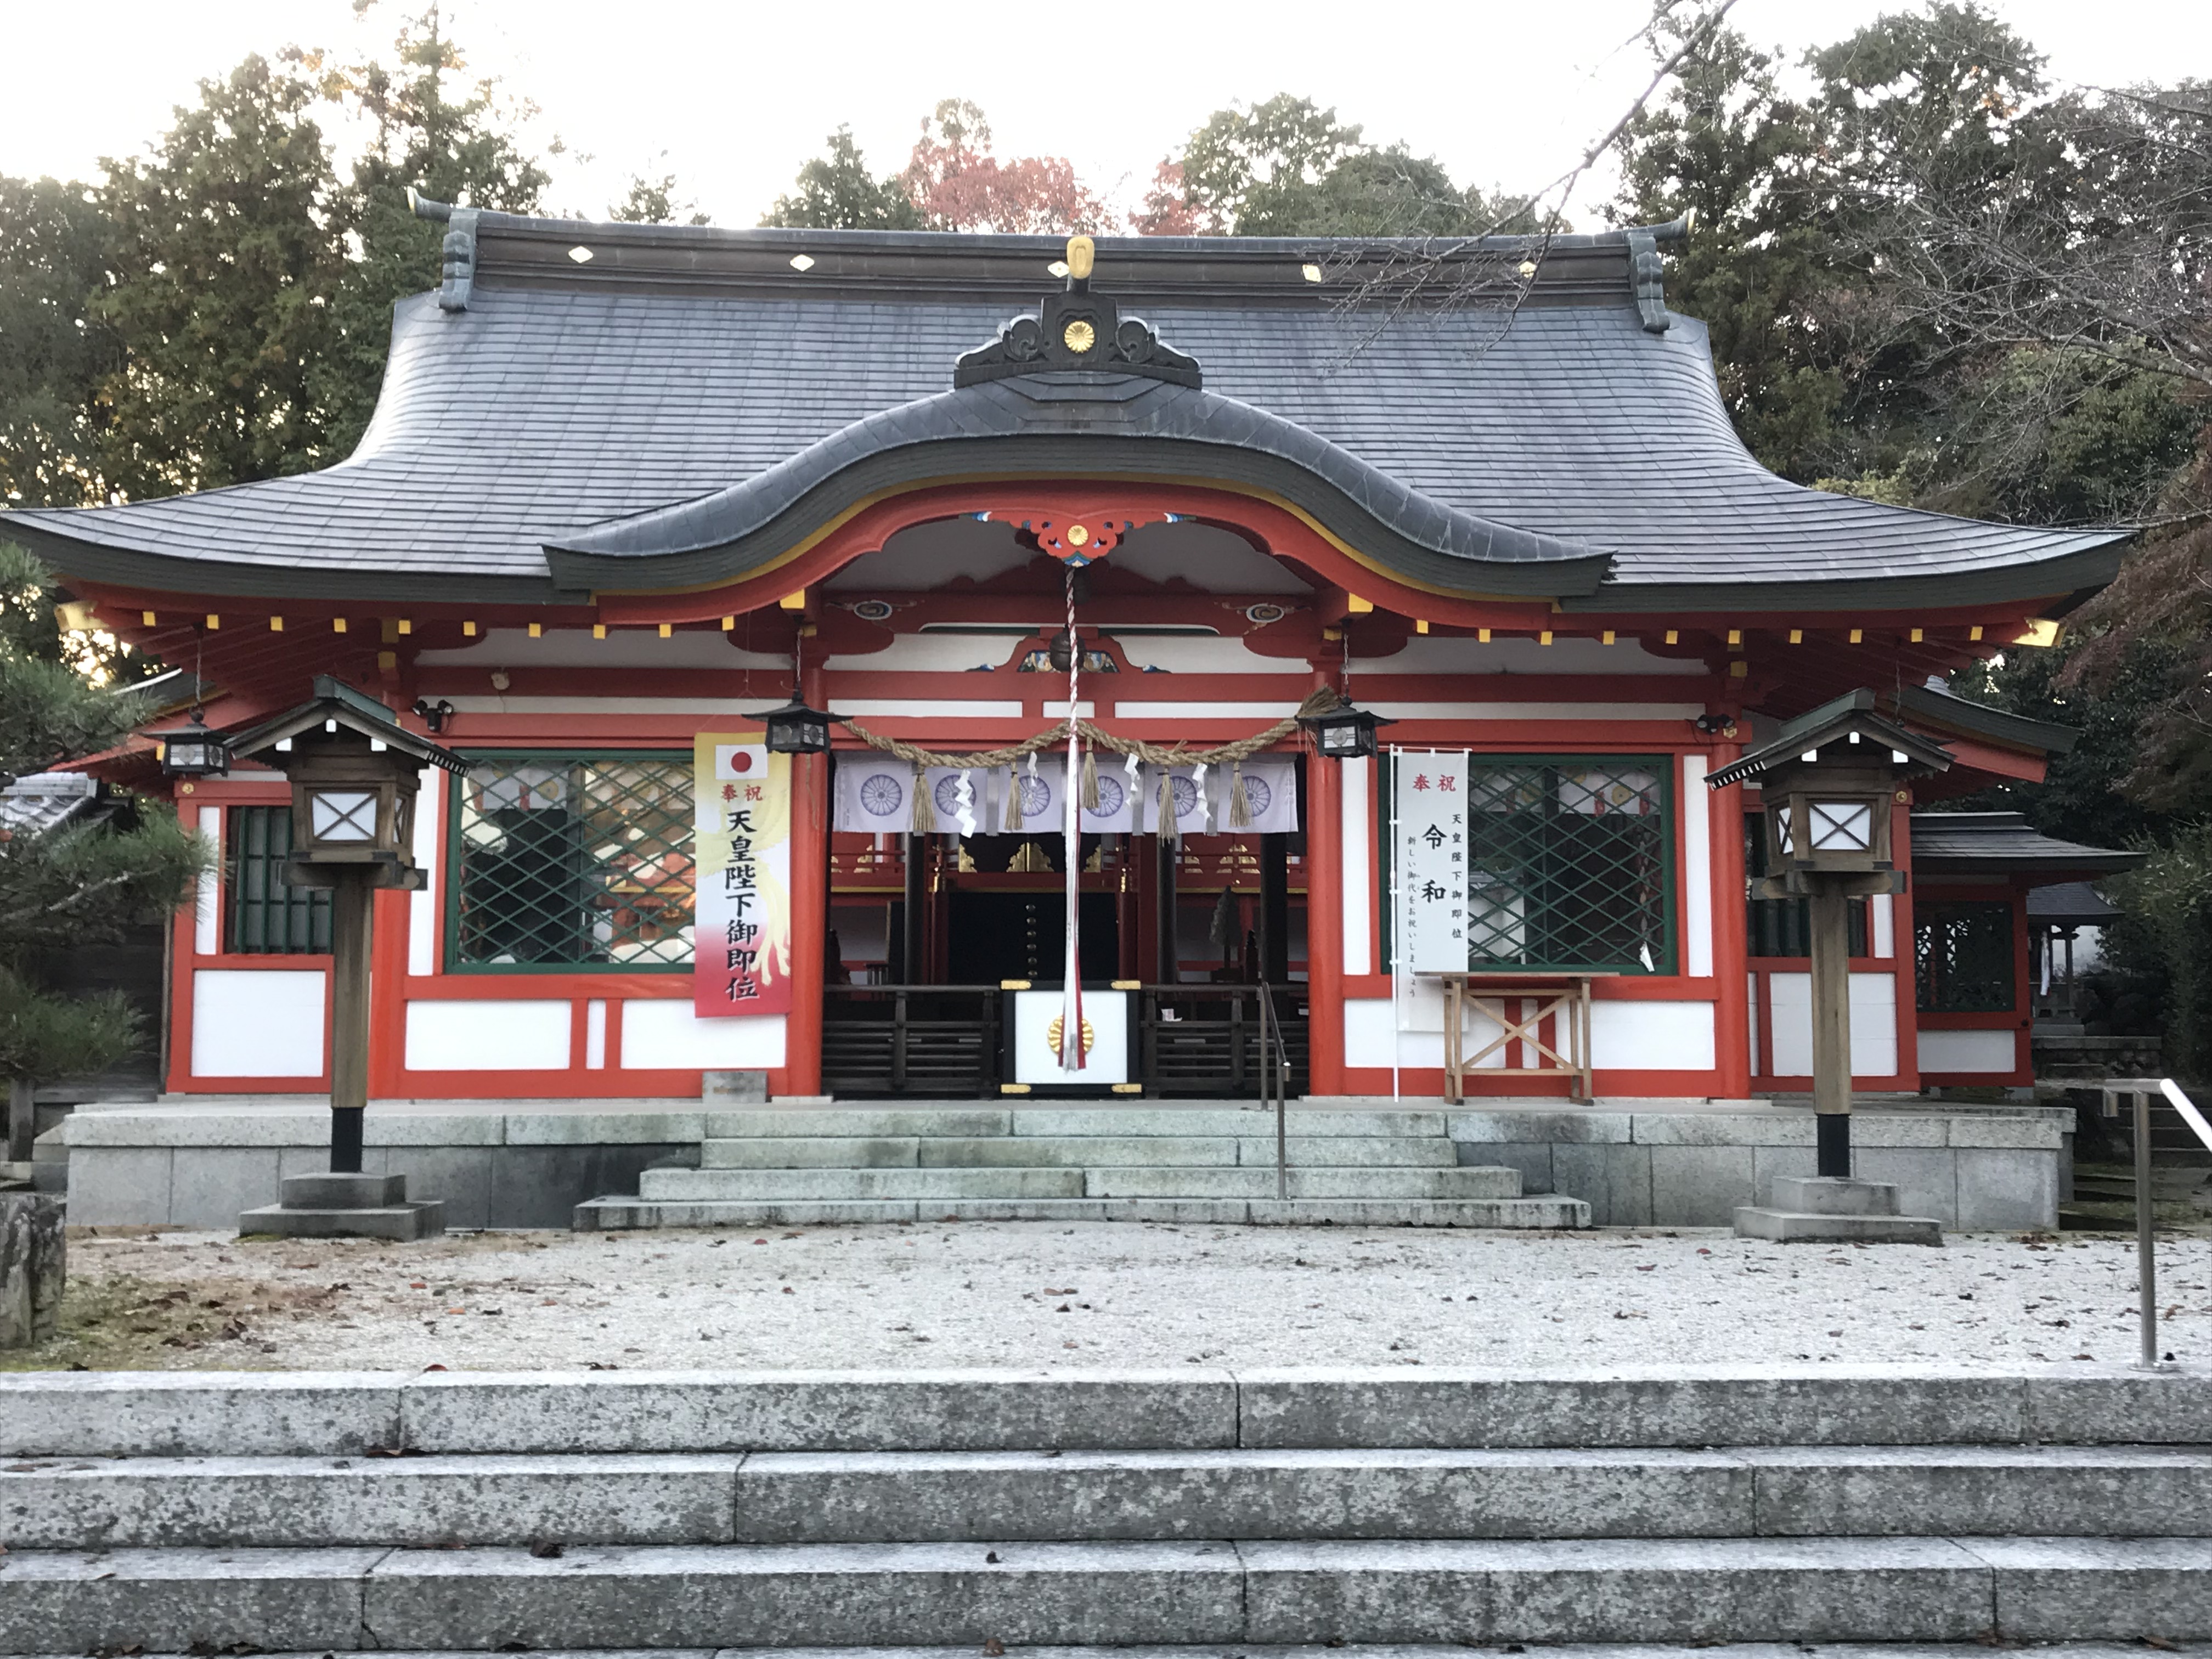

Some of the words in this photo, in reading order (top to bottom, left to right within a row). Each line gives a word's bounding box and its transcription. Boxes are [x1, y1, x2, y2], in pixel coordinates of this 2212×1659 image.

[721, 784, 763, 803] 奉祝
[1412, 774, 1457, 792] 奉祝
[1421, 823, 1447, 904] 令和
[1451, 814, 1463, 939] 天皇陛下御即位
[725, 810, 760, 1003] 天皇陛下御即位
